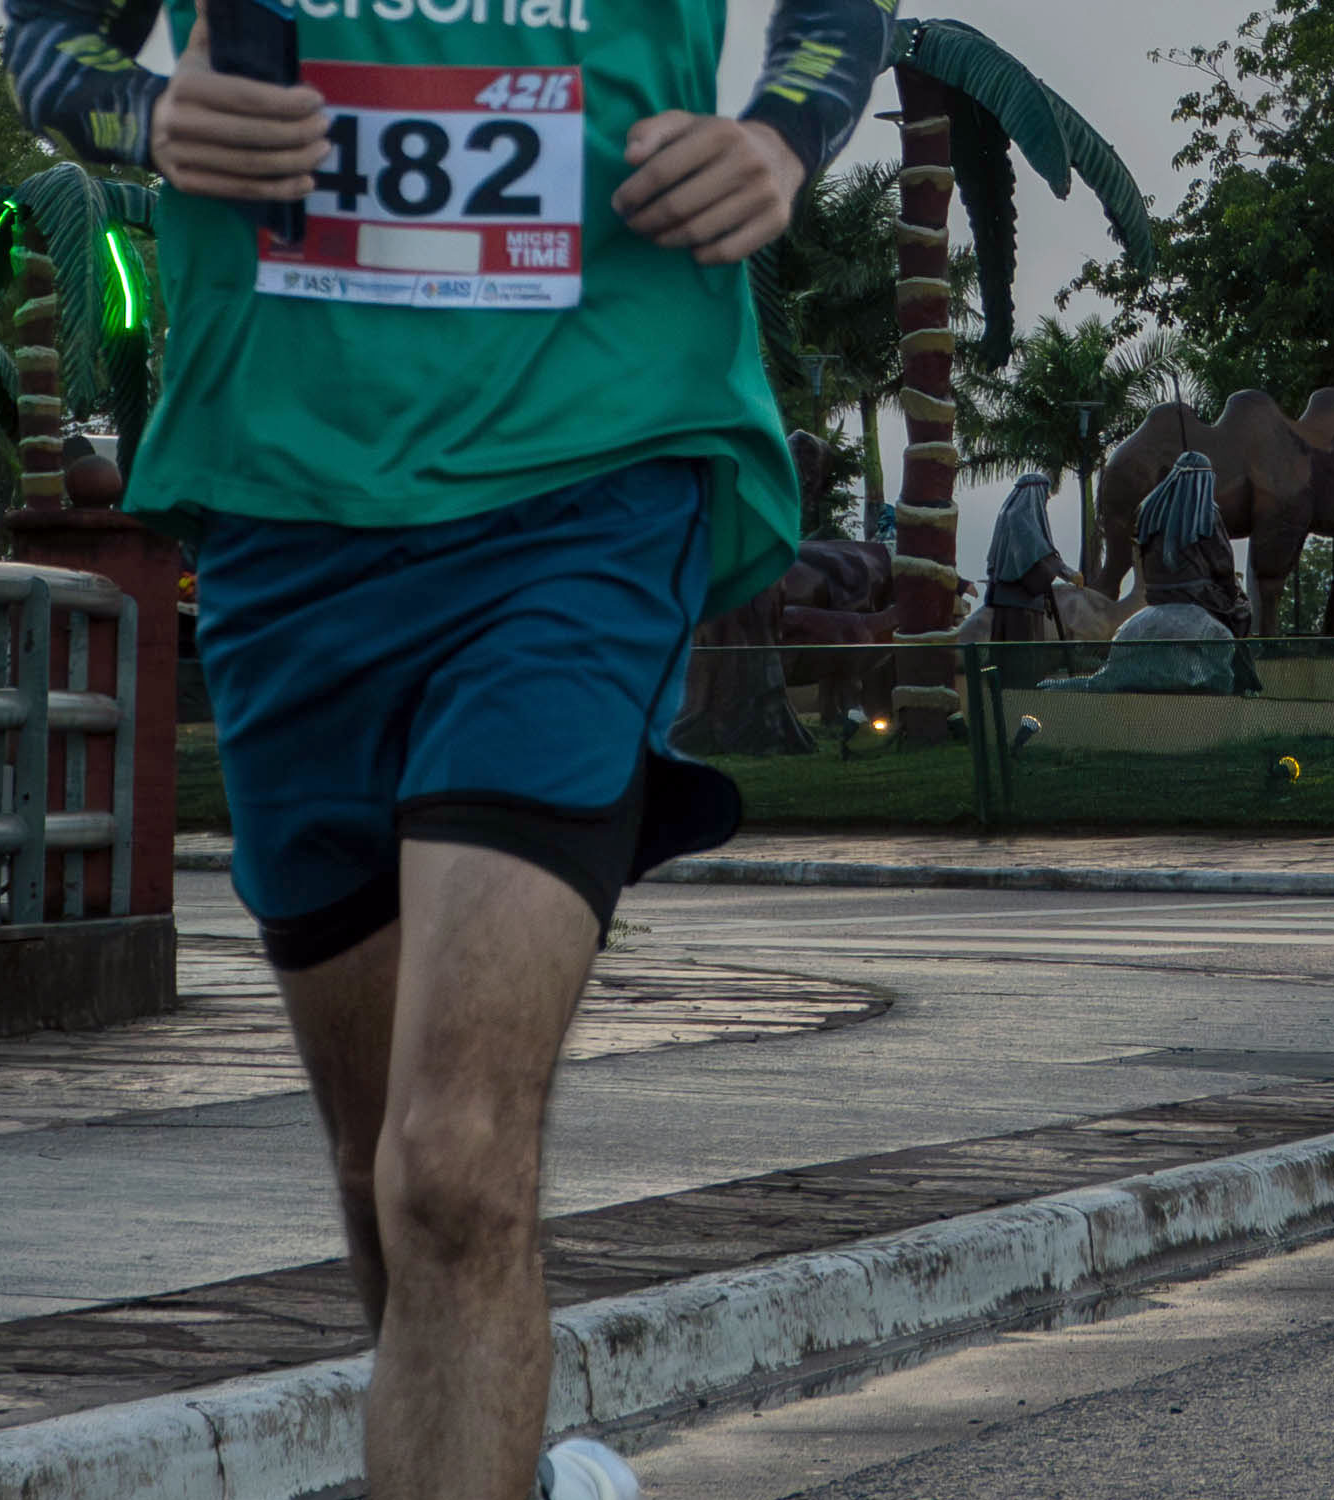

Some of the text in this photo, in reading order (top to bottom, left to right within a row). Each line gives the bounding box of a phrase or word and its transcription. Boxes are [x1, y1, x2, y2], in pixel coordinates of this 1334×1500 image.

[475, 73, 574, 110] 42K
[313, 114, 542, 217] 482
[507, 248, 570, 268] TIME
